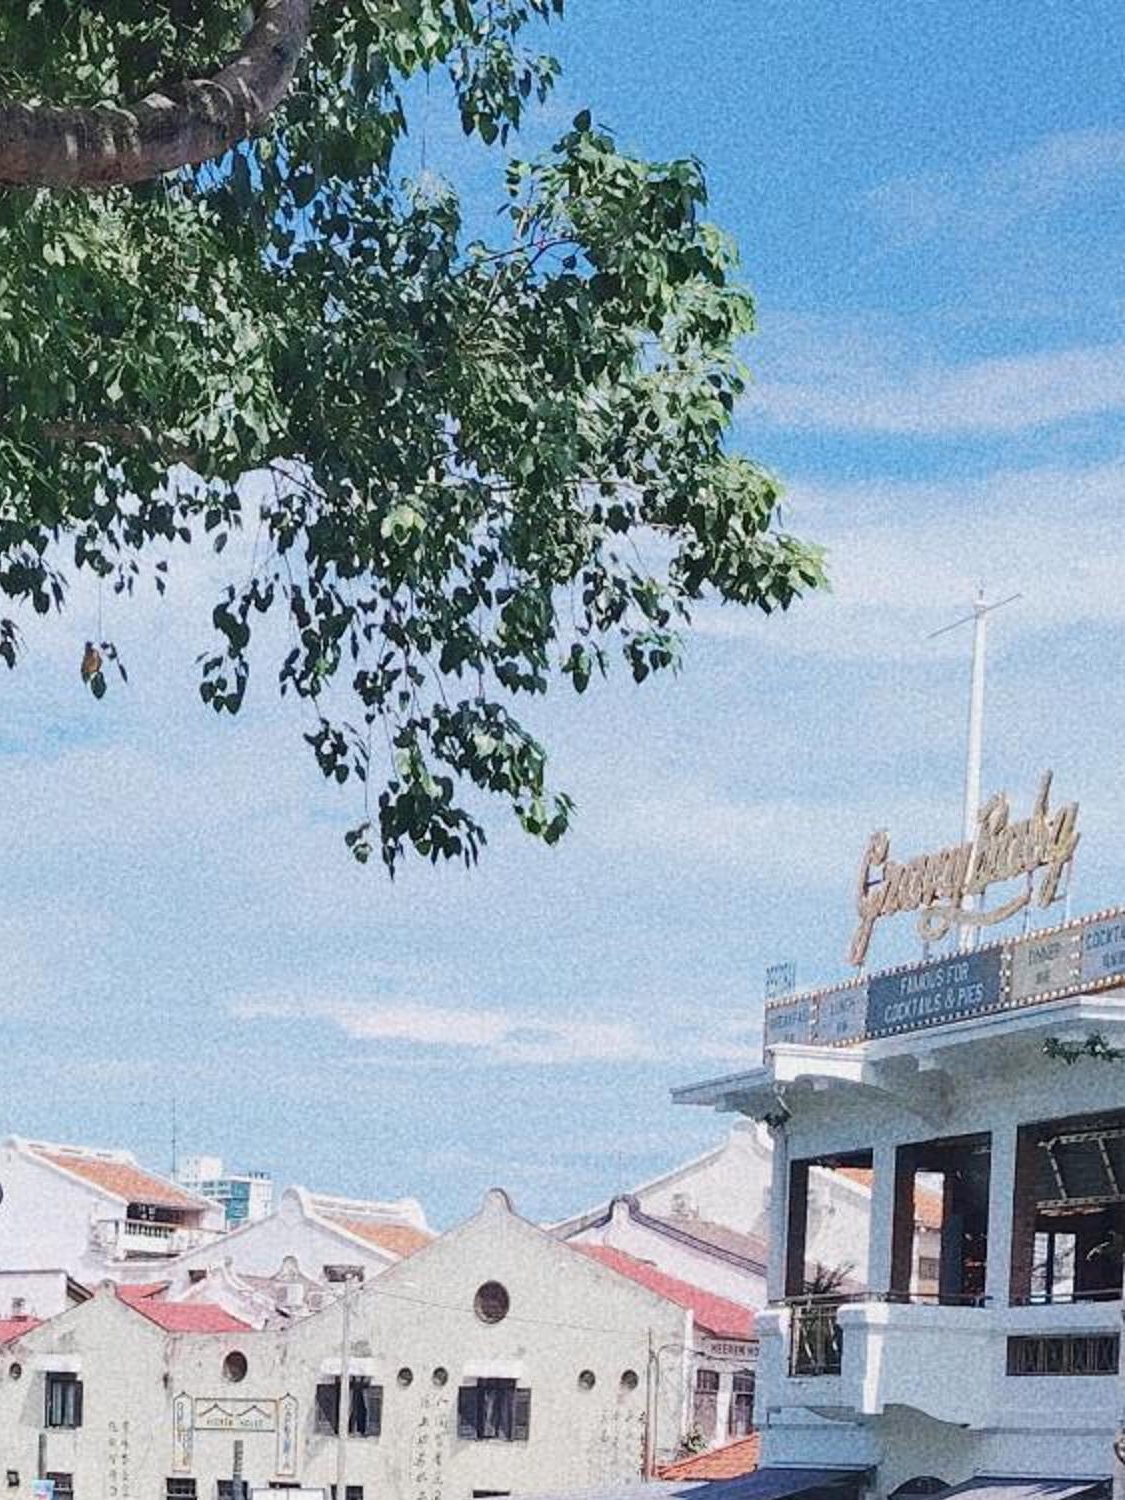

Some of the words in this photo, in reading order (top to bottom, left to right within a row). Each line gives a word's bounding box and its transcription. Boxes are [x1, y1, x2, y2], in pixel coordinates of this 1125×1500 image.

[899, 966, 945, 996] FAMOUS
[946, 961, 970, 984] FOR
[884, 992, 942, 1023] COCKTAILS
[945, 986, 957, 1009] &
[958, 982, 984, 1008] PIES
